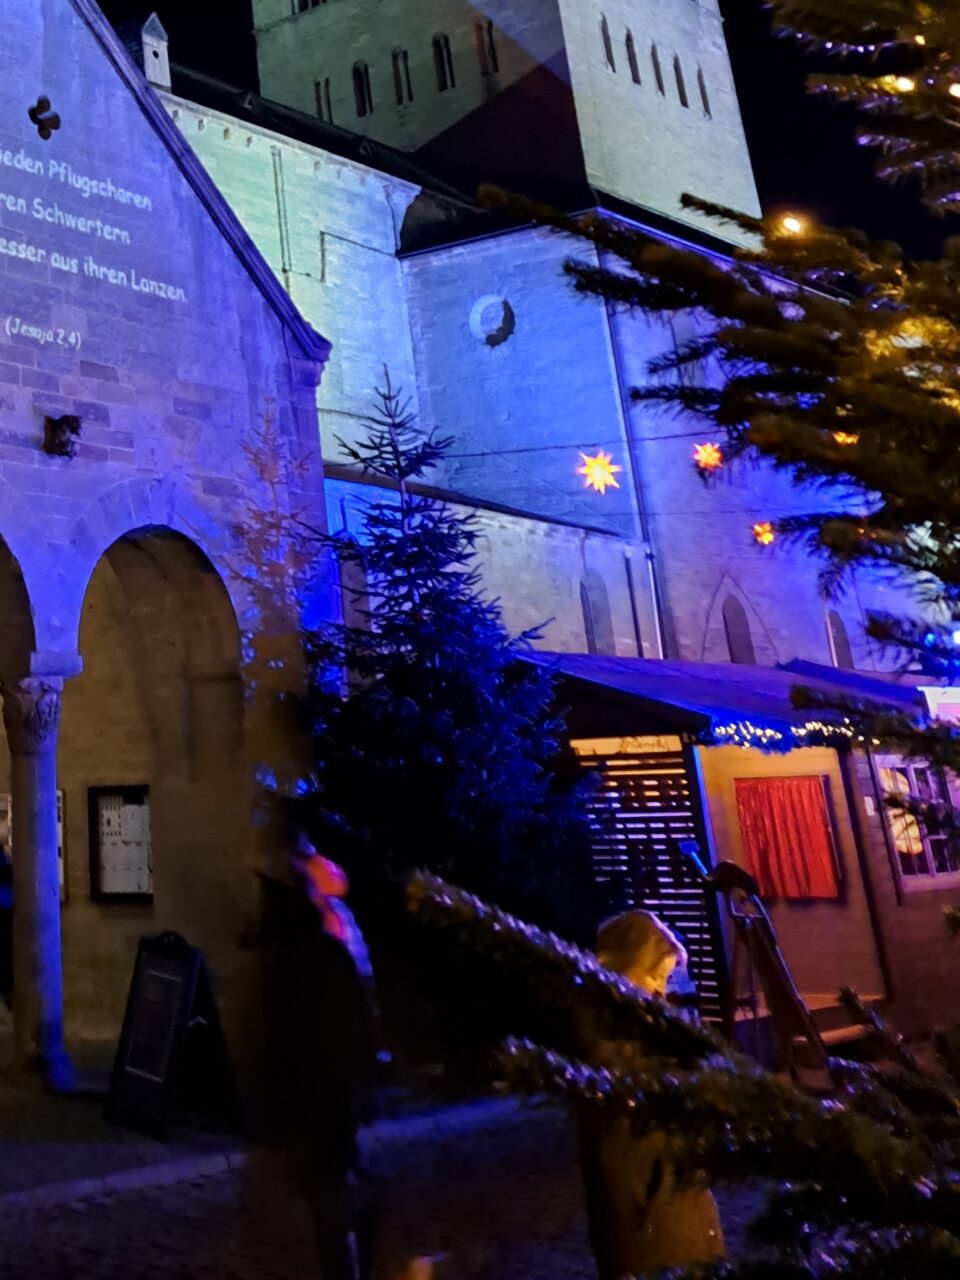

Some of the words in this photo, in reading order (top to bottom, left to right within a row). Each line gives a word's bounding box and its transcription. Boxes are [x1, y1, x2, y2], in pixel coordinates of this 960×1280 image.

[48, 159, 152, 211] Pflugscharen
[32, 197, 130, 245] Schwertern
[51, 251, 78, 274] aus
[84, 255, 127, 287] ihren
[5, 316, 54, 345] (Jesaja
